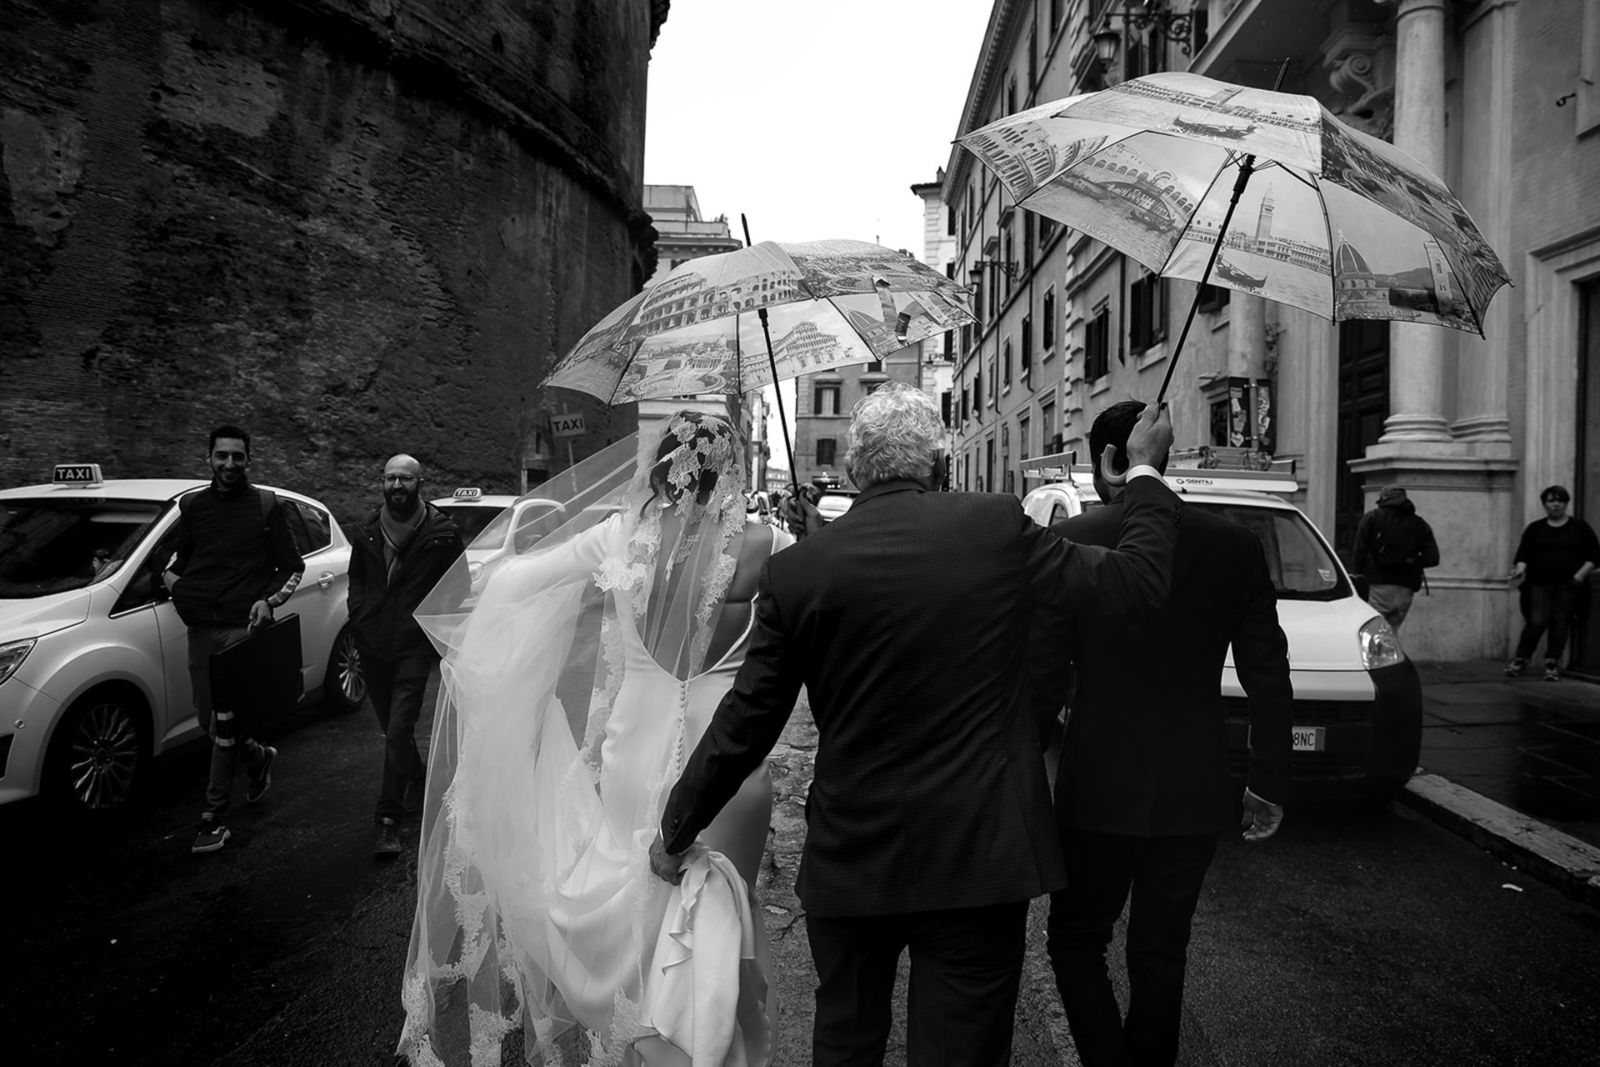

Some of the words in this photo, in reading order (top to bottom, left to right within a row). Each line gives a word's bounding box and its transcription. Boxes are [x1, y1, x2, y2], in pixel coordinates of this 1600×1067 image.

[553, 418, 584, 432] TAXI
[57, 469, 90, 480] TAXI
[455, 489, 478, 497] TAXI
